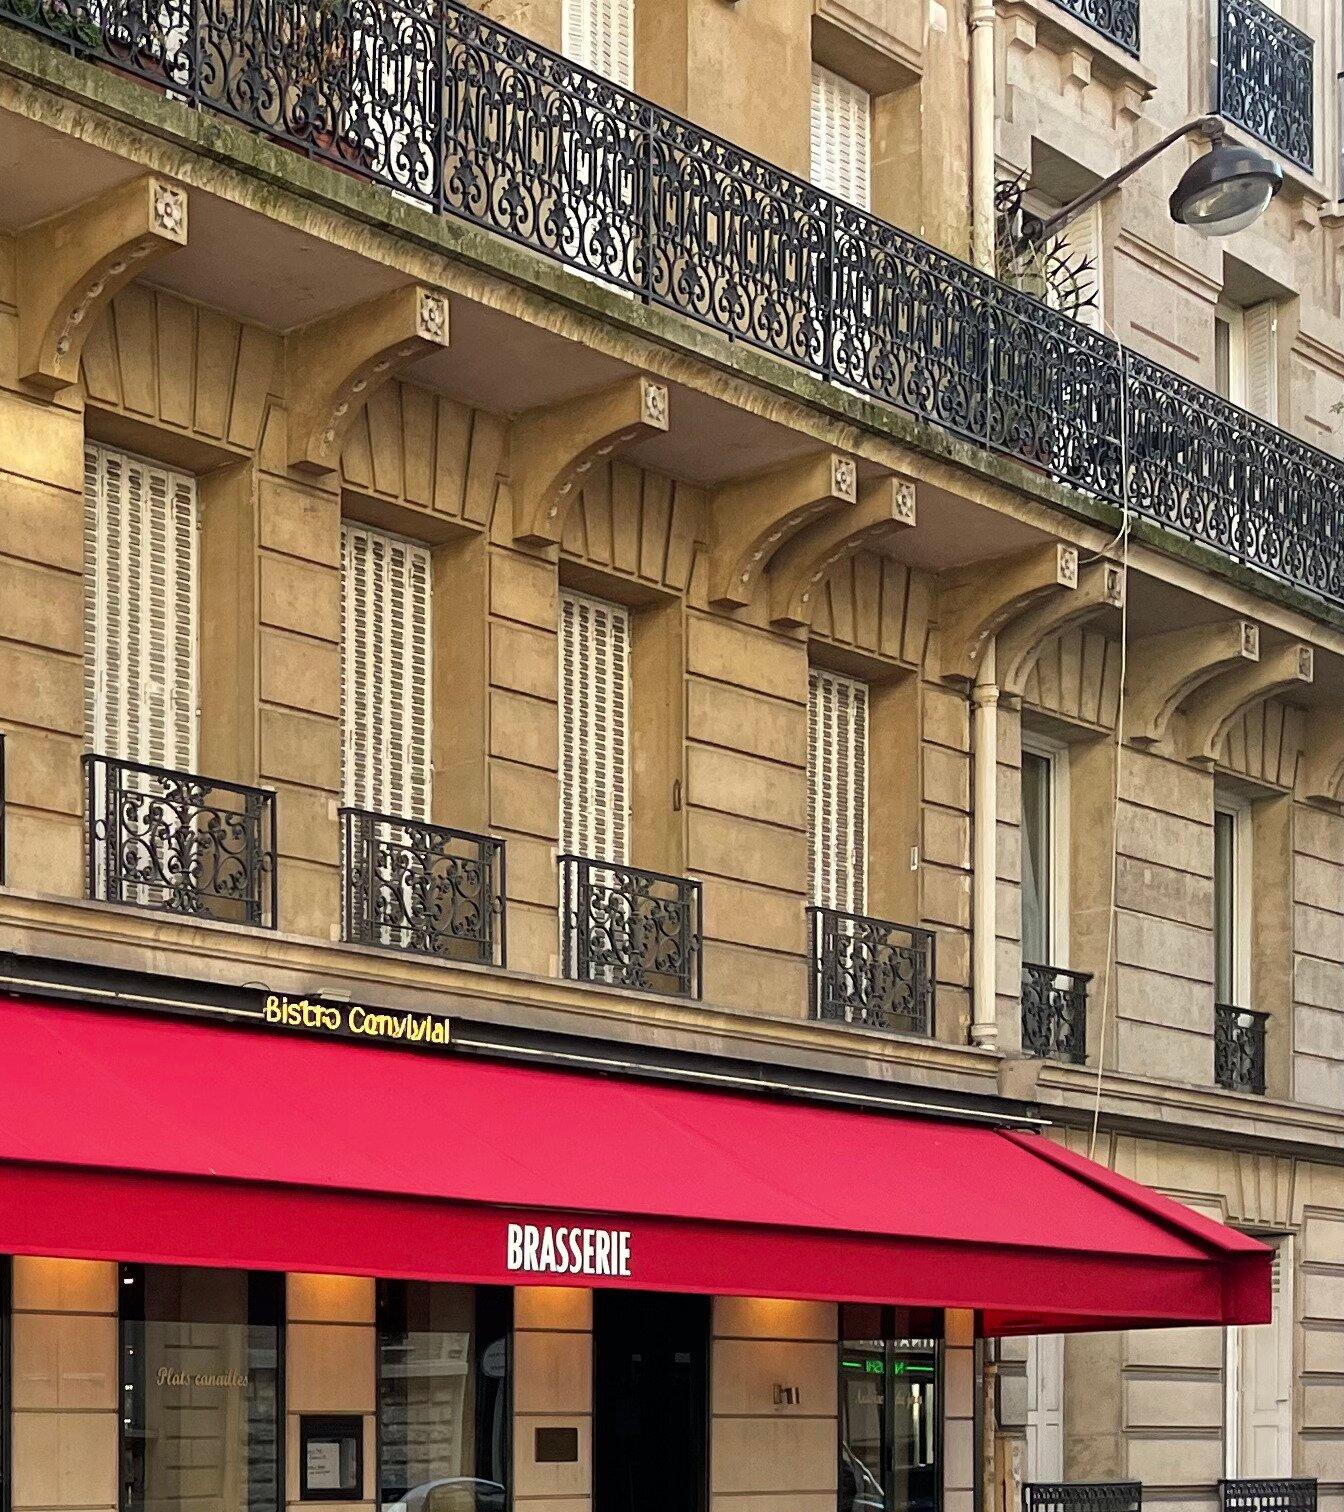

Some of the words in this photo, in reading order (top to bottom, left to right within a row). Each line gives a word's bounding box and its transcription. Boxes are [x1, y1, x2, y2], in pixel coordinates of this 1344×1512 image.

[264, 995, 342, 1031] Bistro
[348, 1006, 451, 1045] Convivial
[507, 1223, 632, 1276] BRASSERIE
[156, 1366, 191, 1387] Plats
[195, 1367, 250, 1388] canailles
